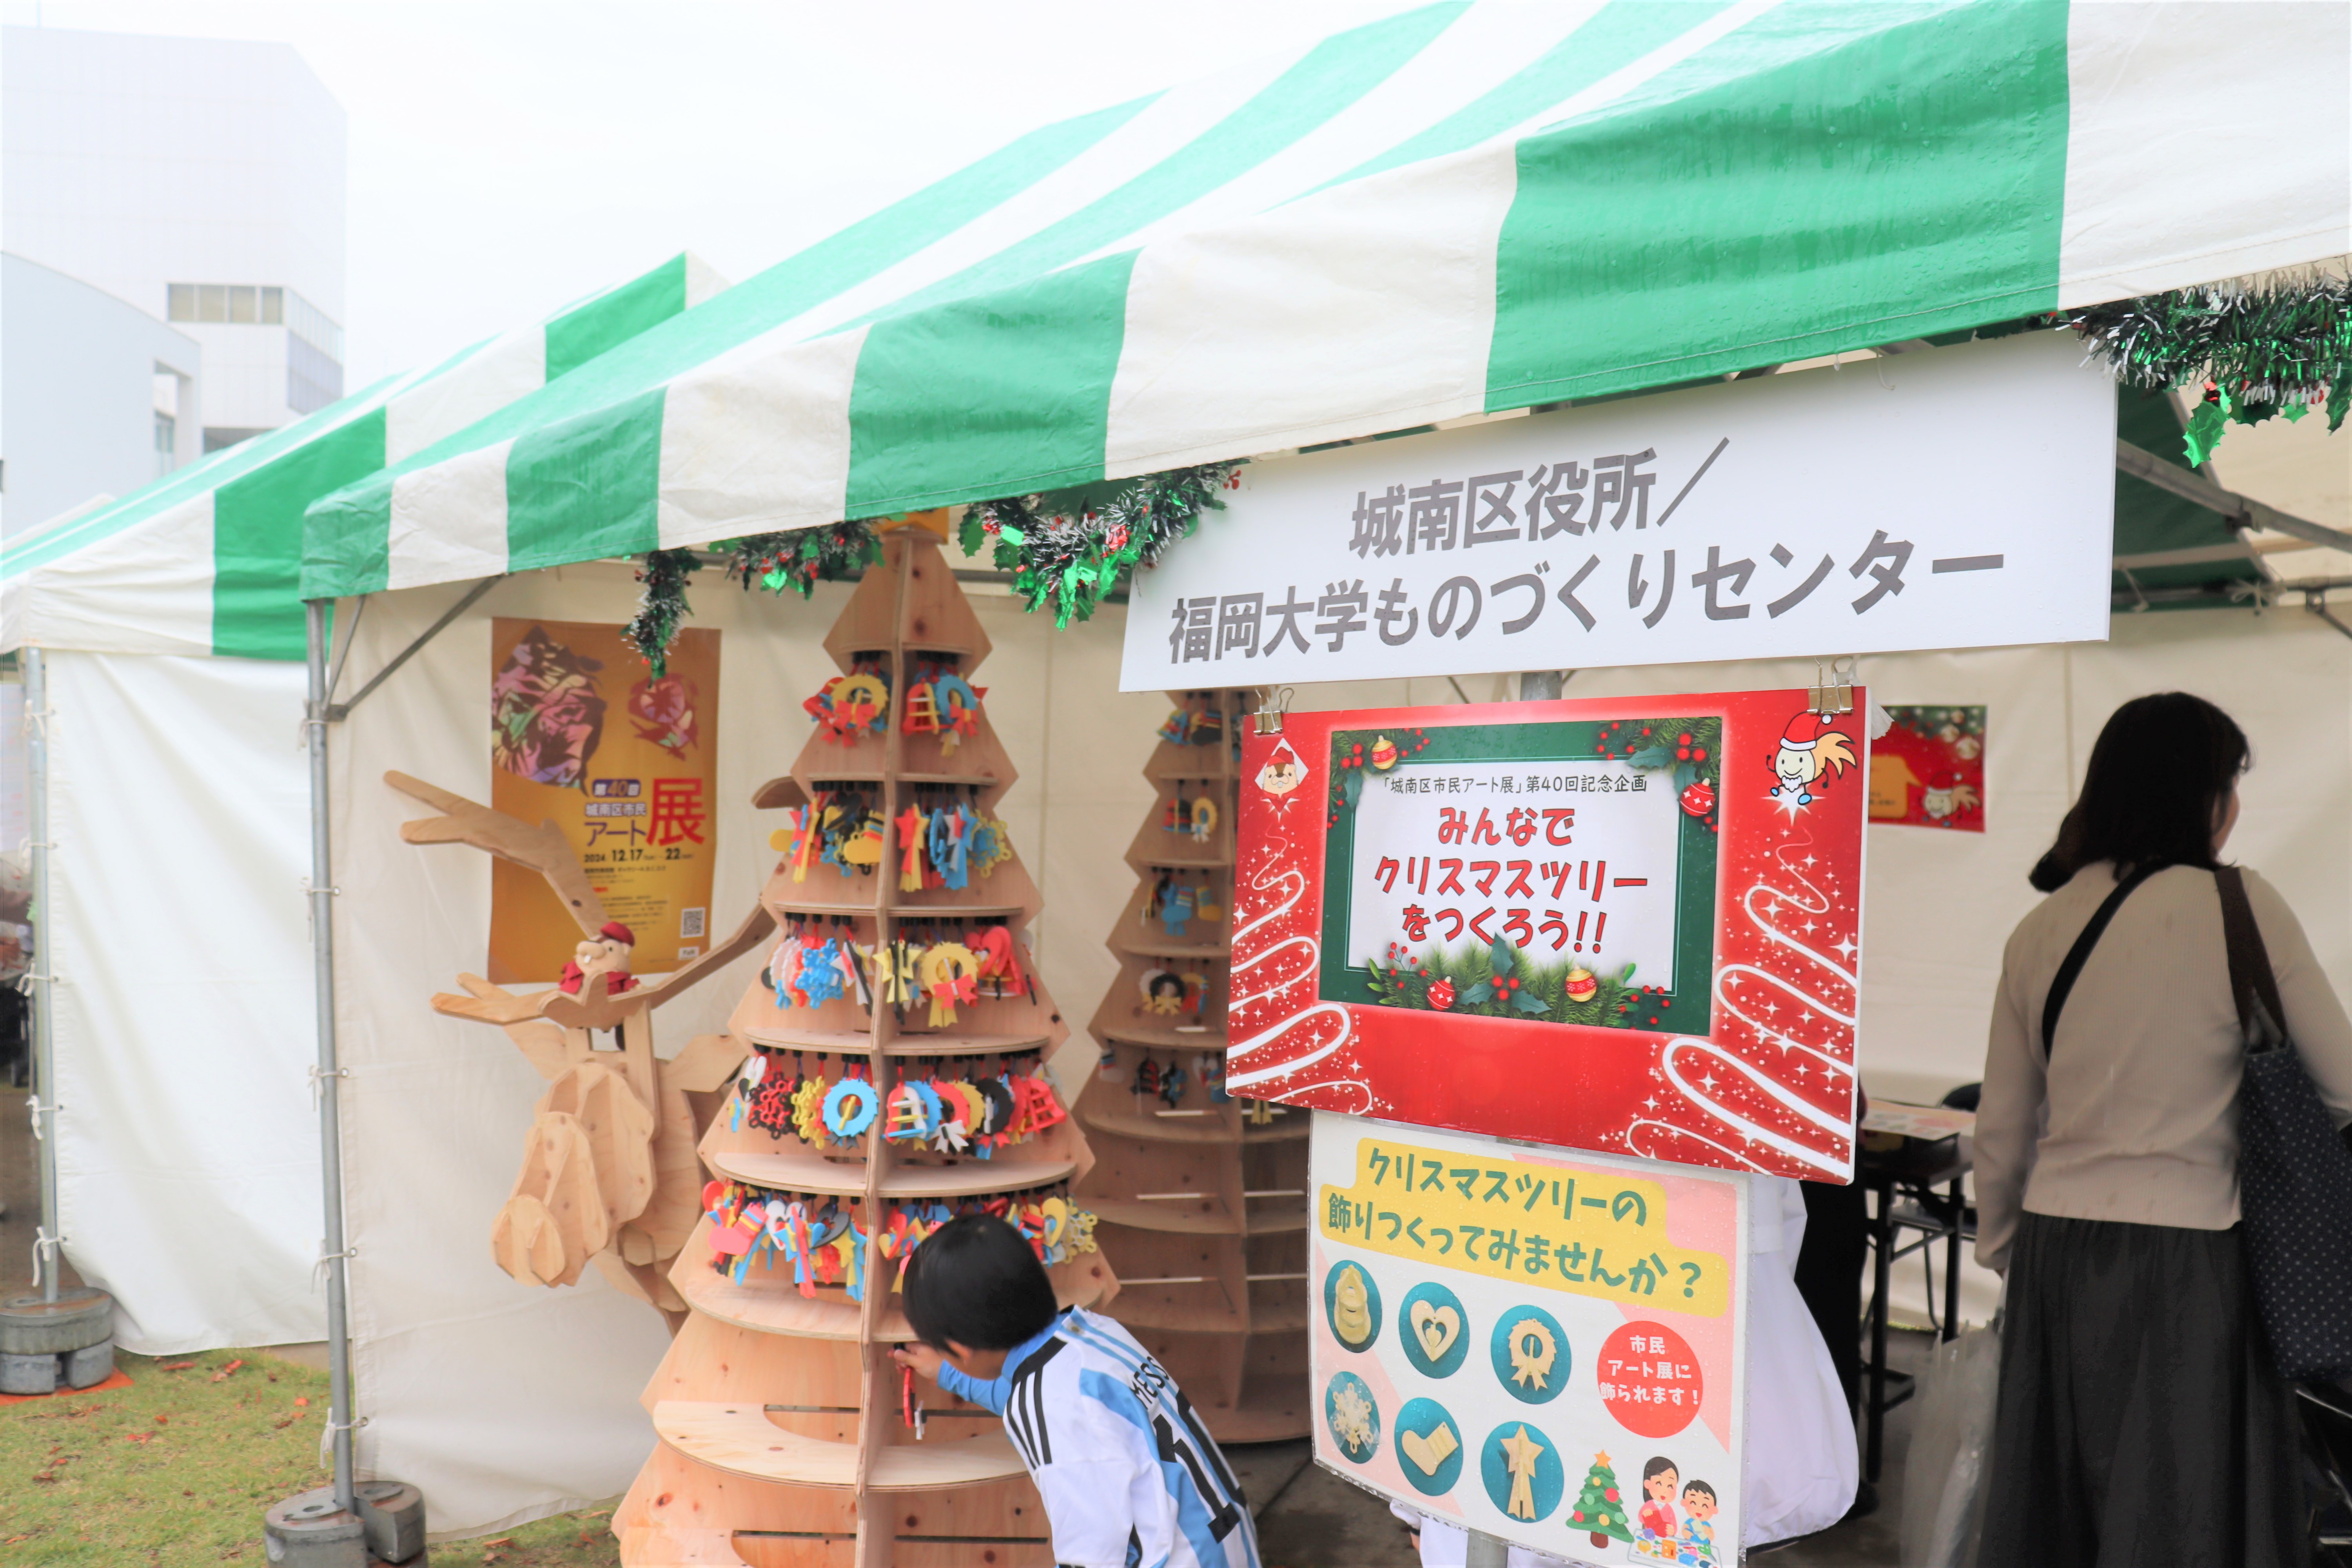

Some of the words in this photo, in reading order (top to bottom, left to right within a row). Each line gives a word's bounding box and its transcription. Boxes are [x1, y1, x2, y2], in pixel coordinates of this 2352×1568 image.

[1350, 437, 1730, 559] 城南区役所／
[1168, 529, 2004, 664] 福岡大学ものづくりセンター
[585, 820, 646, 847] アート
[646, 778, 706, 846] 展
[1438, 806, 1575, 848] みんなで
[666, 848, 681, 860] 22
[1374, 857, 1648, 902] クリスマスツリー
[1368, 1147, 1646, 1227] クリスマスツリーの
[1328, 1192, 1702, 1298] 飾りつくってみませんか？
[1630, 1335, 1665, 1354] 市民
[1129, 1356, 1169, 1410] MESS
[1607, 1359, 1692, 1380] アート展に
[1599, 1382, 1699, 1405] 飾られます！
